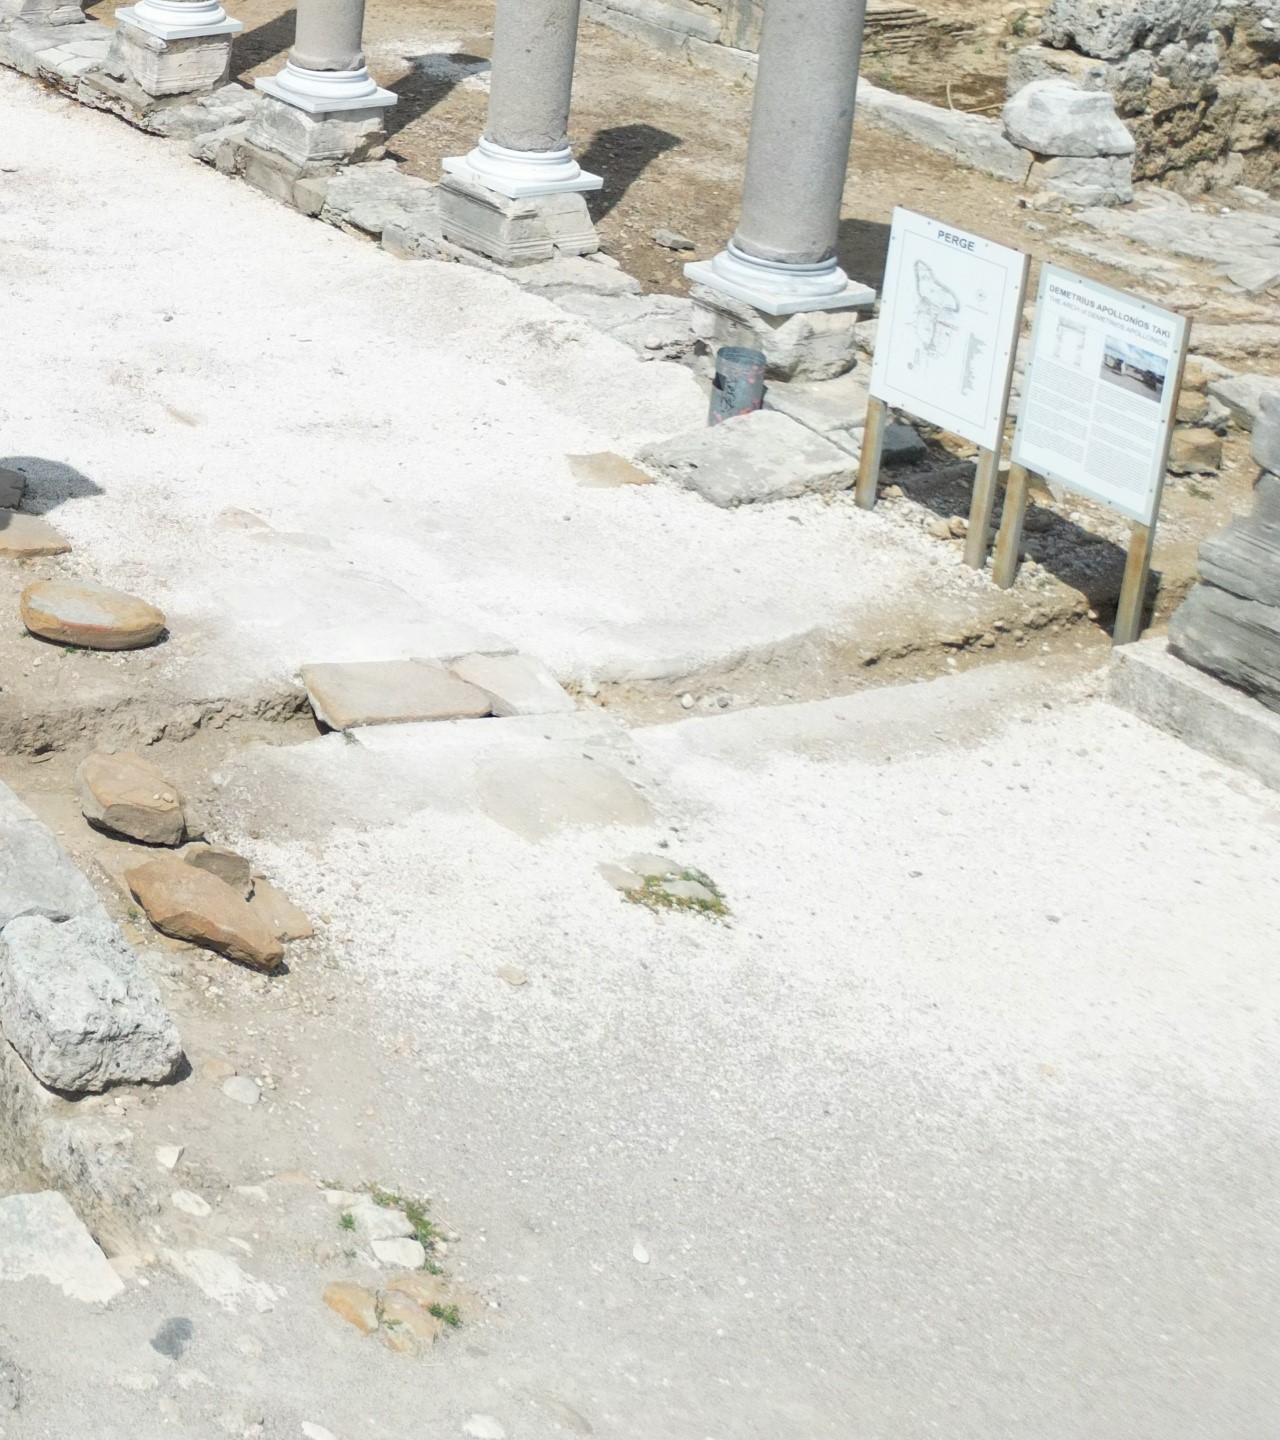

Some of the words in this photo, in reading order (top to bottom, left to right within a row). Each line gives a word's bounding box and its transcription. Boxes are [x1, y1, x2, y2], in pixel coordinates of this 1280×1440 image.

[938, 229, 975, 251] PERGE
[1049, 295, 1061, 305] THE
[1062, 301, 1080, 313] ARCH
[1125, 324, 1168, 347] APOLLONIOS
